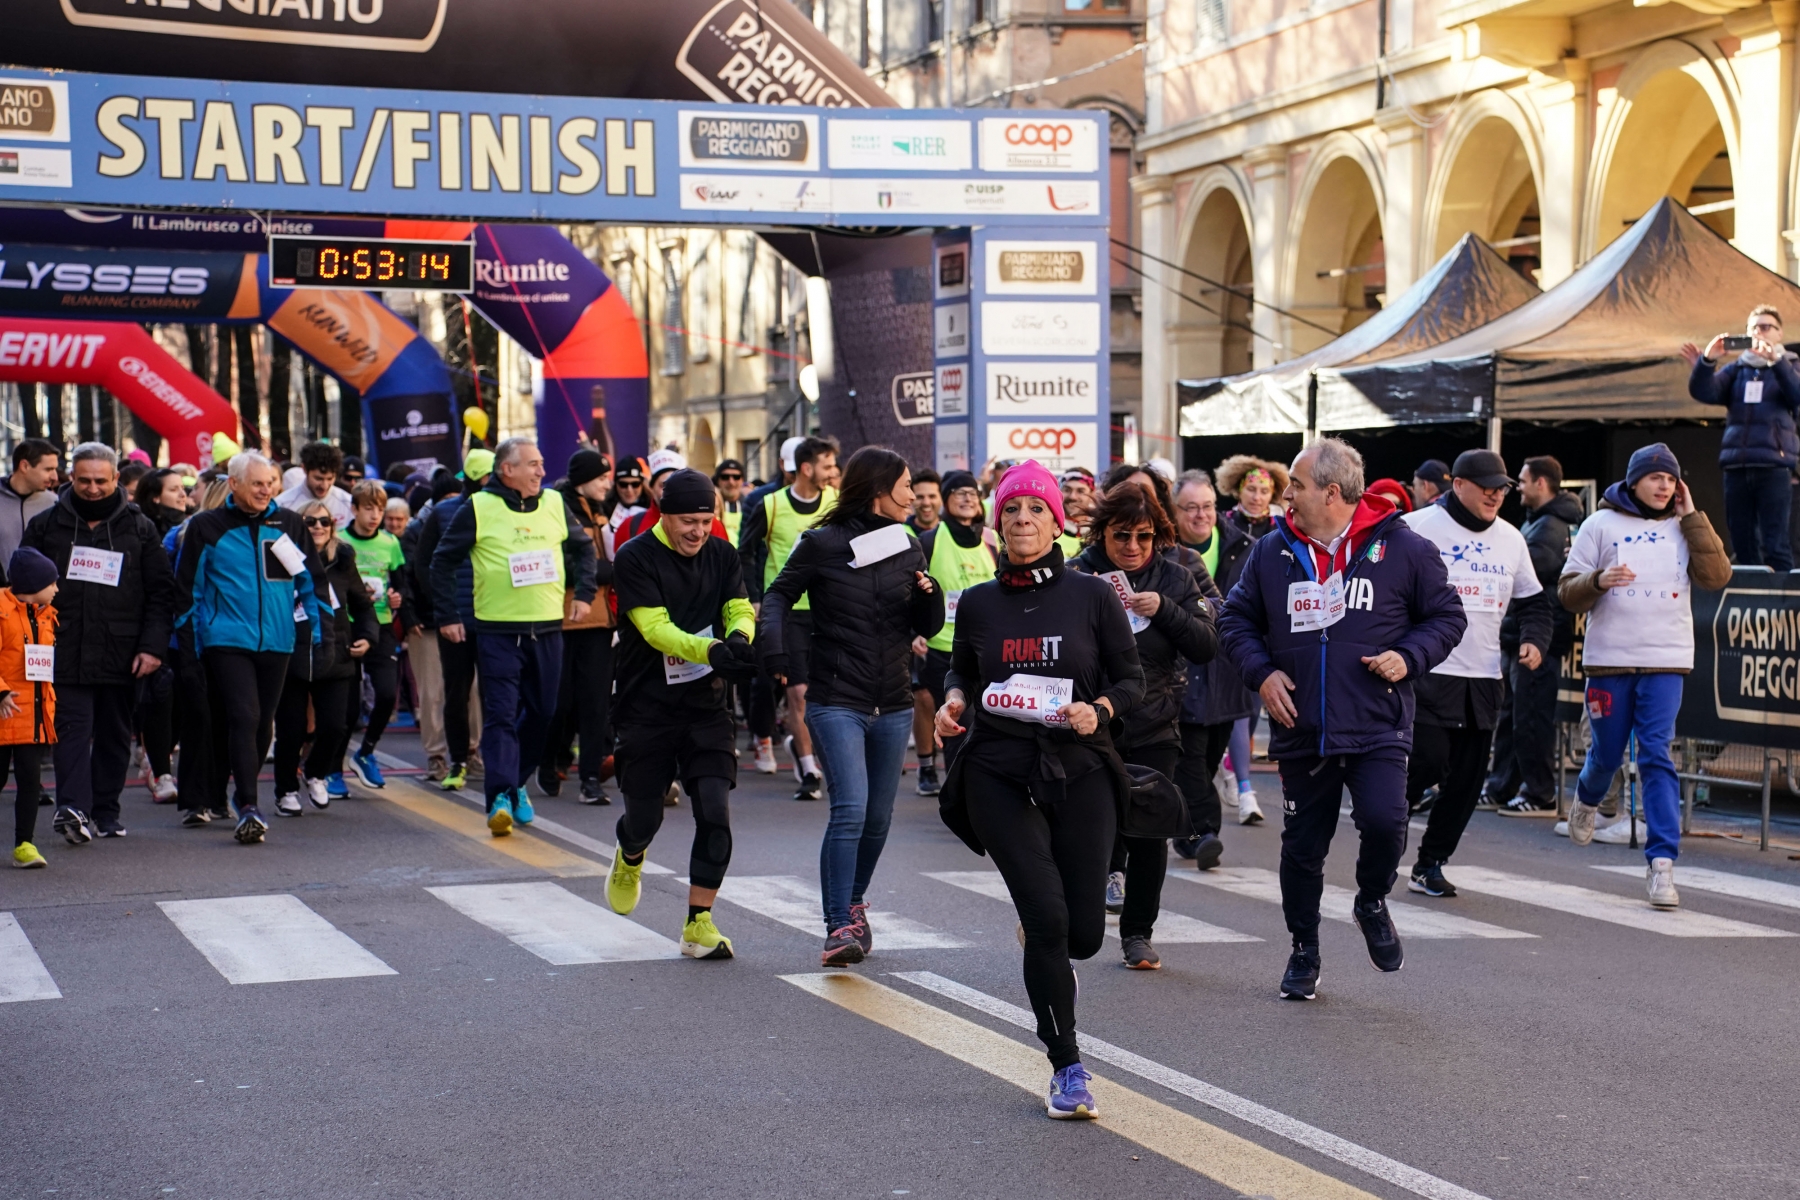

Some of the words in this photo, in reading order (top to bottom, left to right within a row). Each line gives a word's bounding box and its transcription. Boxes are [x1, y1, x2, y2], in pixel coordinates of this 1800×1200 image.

[717, 52, 802, 106] REG
[697, 120, 800, 140] PARMIGIANO
[96, 95, 656, 196] START/FINISH
[708, 138, 791, 157] REGGIANO
[913, 136, 946, 156] RER
[148, 217, 240, 233] Lambrusco
[242, 219, 258, 233] ci
[320, 248, 450, 280] 0:53:14
[1004, 252, 1079, 267] PARMIGIANO
[475, 258, 570, 288] Riunite
[1011, 265, 1073, 280] REGGIANO
[61, 294, 130, 307] RUNNING
[131, 297, 201, 309] COMPANY
[995, 374, 1089, 403] Riunite
[72, 558, 101, 569] 0495
[512, 562, 540, 574] 0617
[1456, 585, 1480, 596] 492
[1727, 606, 1800, 652] PARMI
[28, 657, 51, 667] 0496
[1009, 661, 1054, 669] RUNNING
[1045, 684, 1068, 697] RUN
[986, 693, 1038, 711] 0041
[1049, 696, 1062, 708] 4
